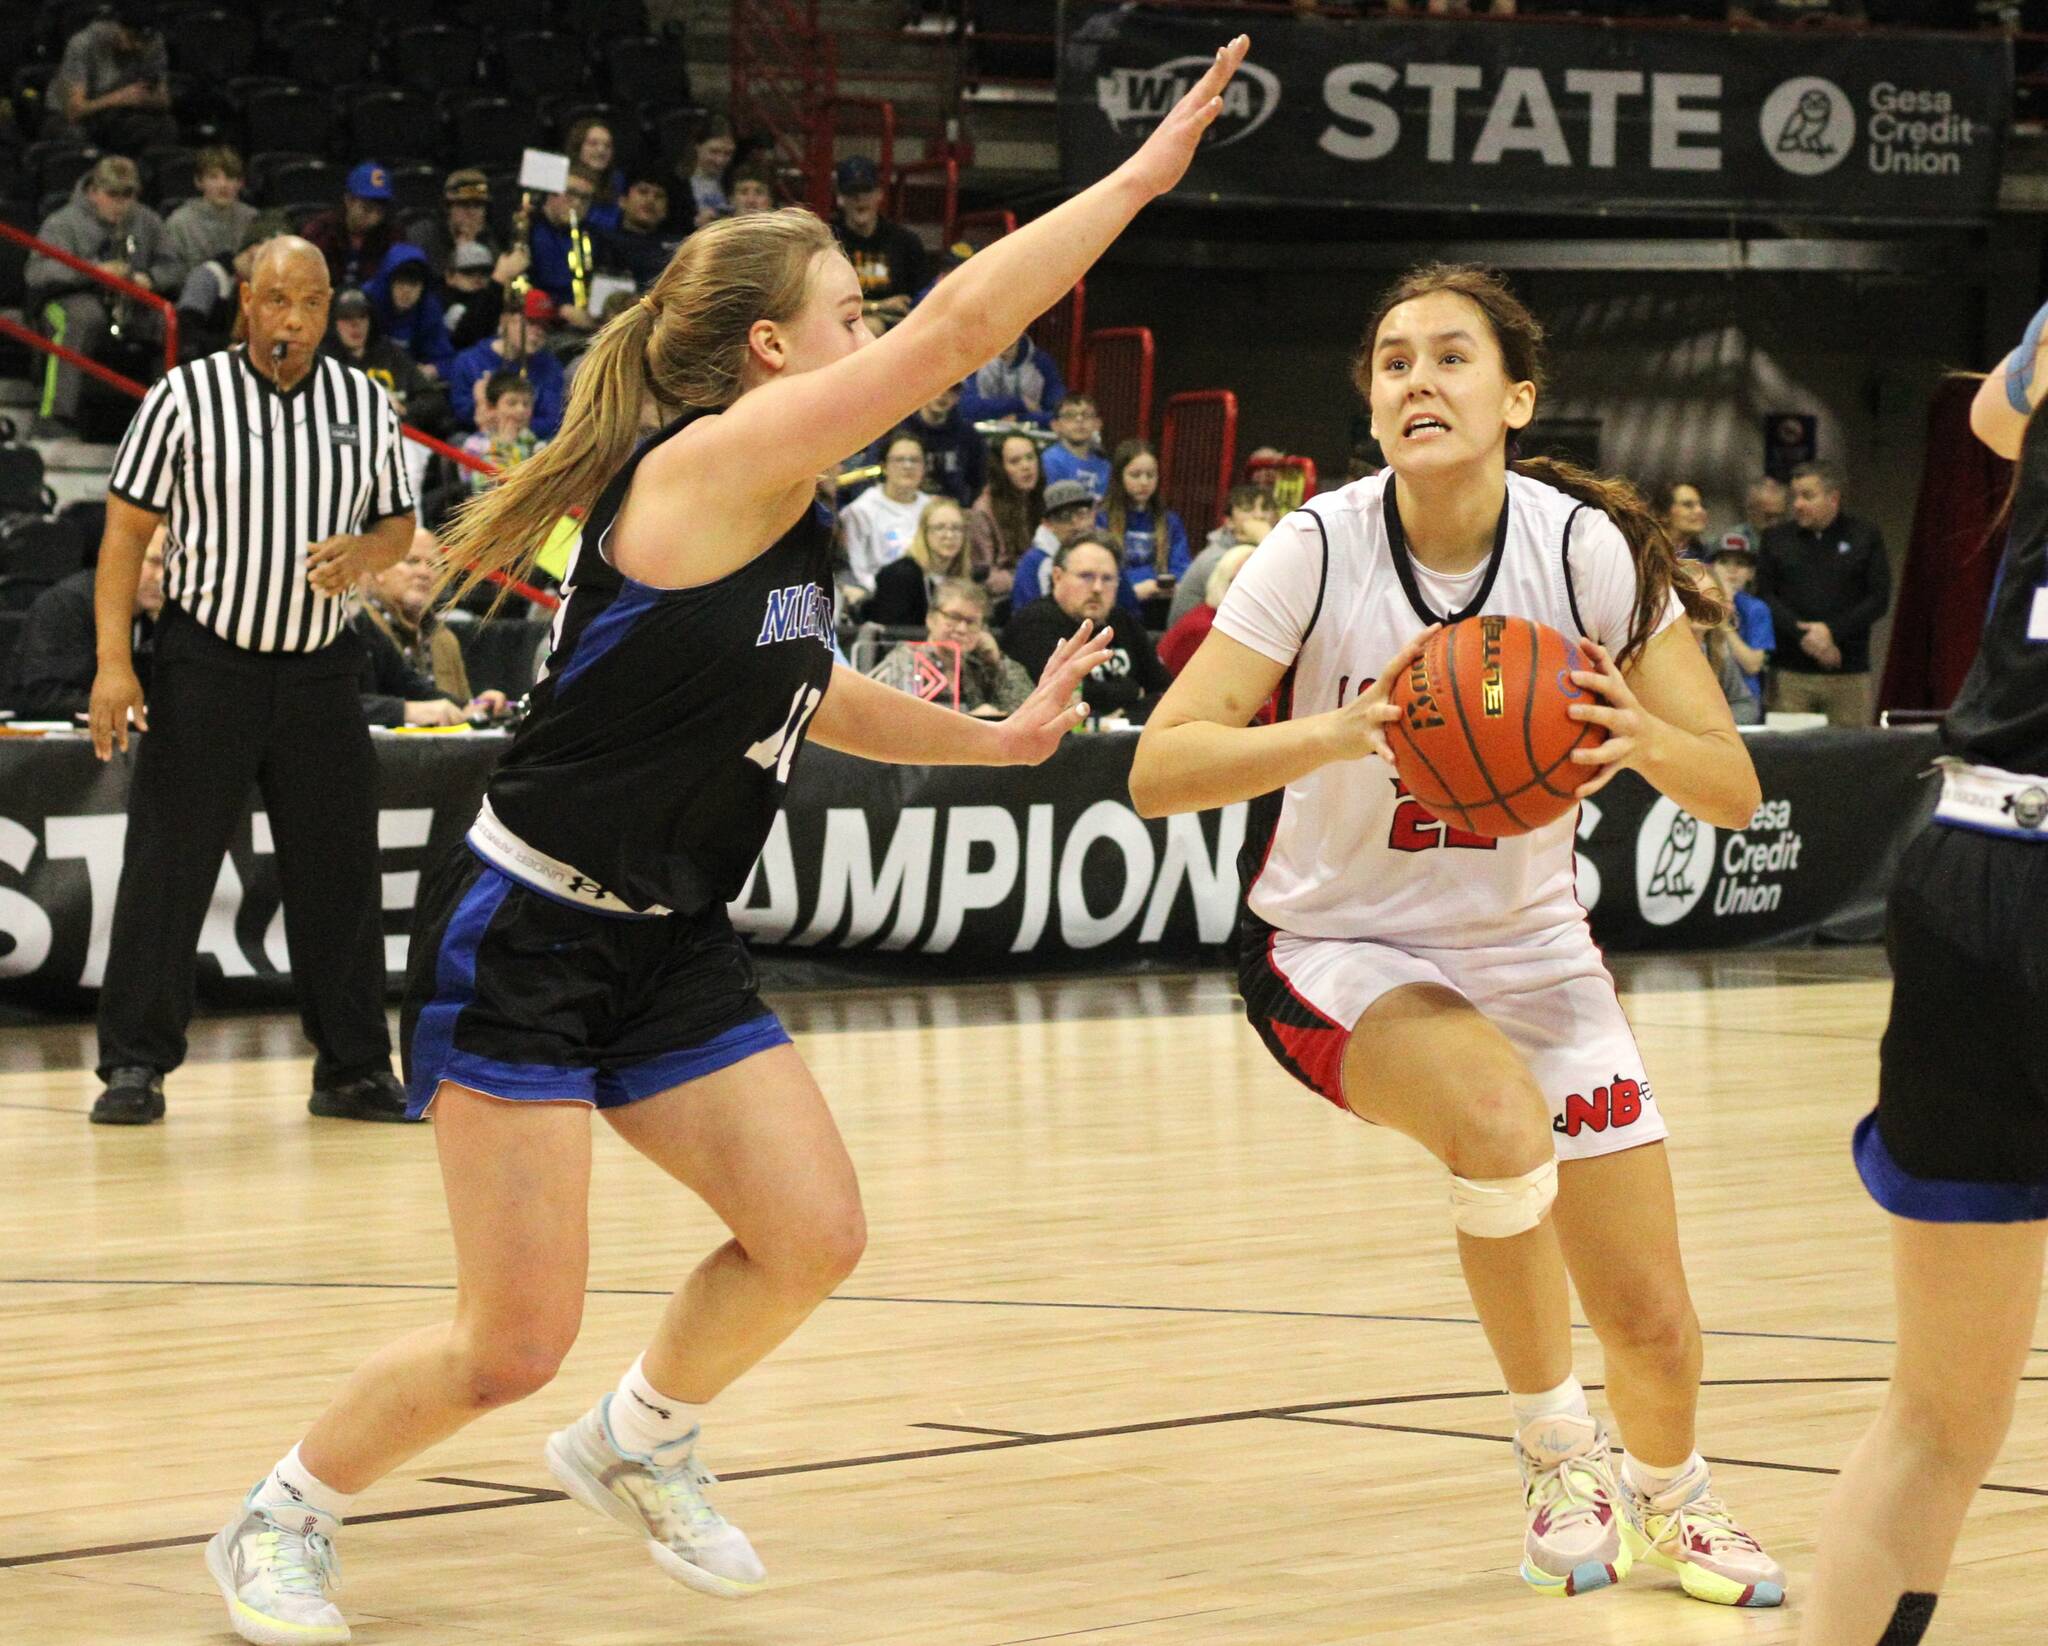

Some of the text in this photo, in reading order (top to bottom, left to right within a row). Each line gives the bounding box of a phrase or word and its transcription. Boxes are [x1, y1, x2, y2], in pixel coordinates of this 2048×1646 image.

[1126, 74, 1251, 118] WIA
[1317, 61, 1723, 171] STATE
[1868, 81, 1952, 114] Gesa
[1867, 112, 1975, 145] Credit
[1868, 141, 1961, 174] Union
[1749, 799, 1792, 831] esa
[1722, 831, 1802, 875] Credit
[1713, 874, 1783, 917] Union
[1565, 1078, 1642, 1138] NB
